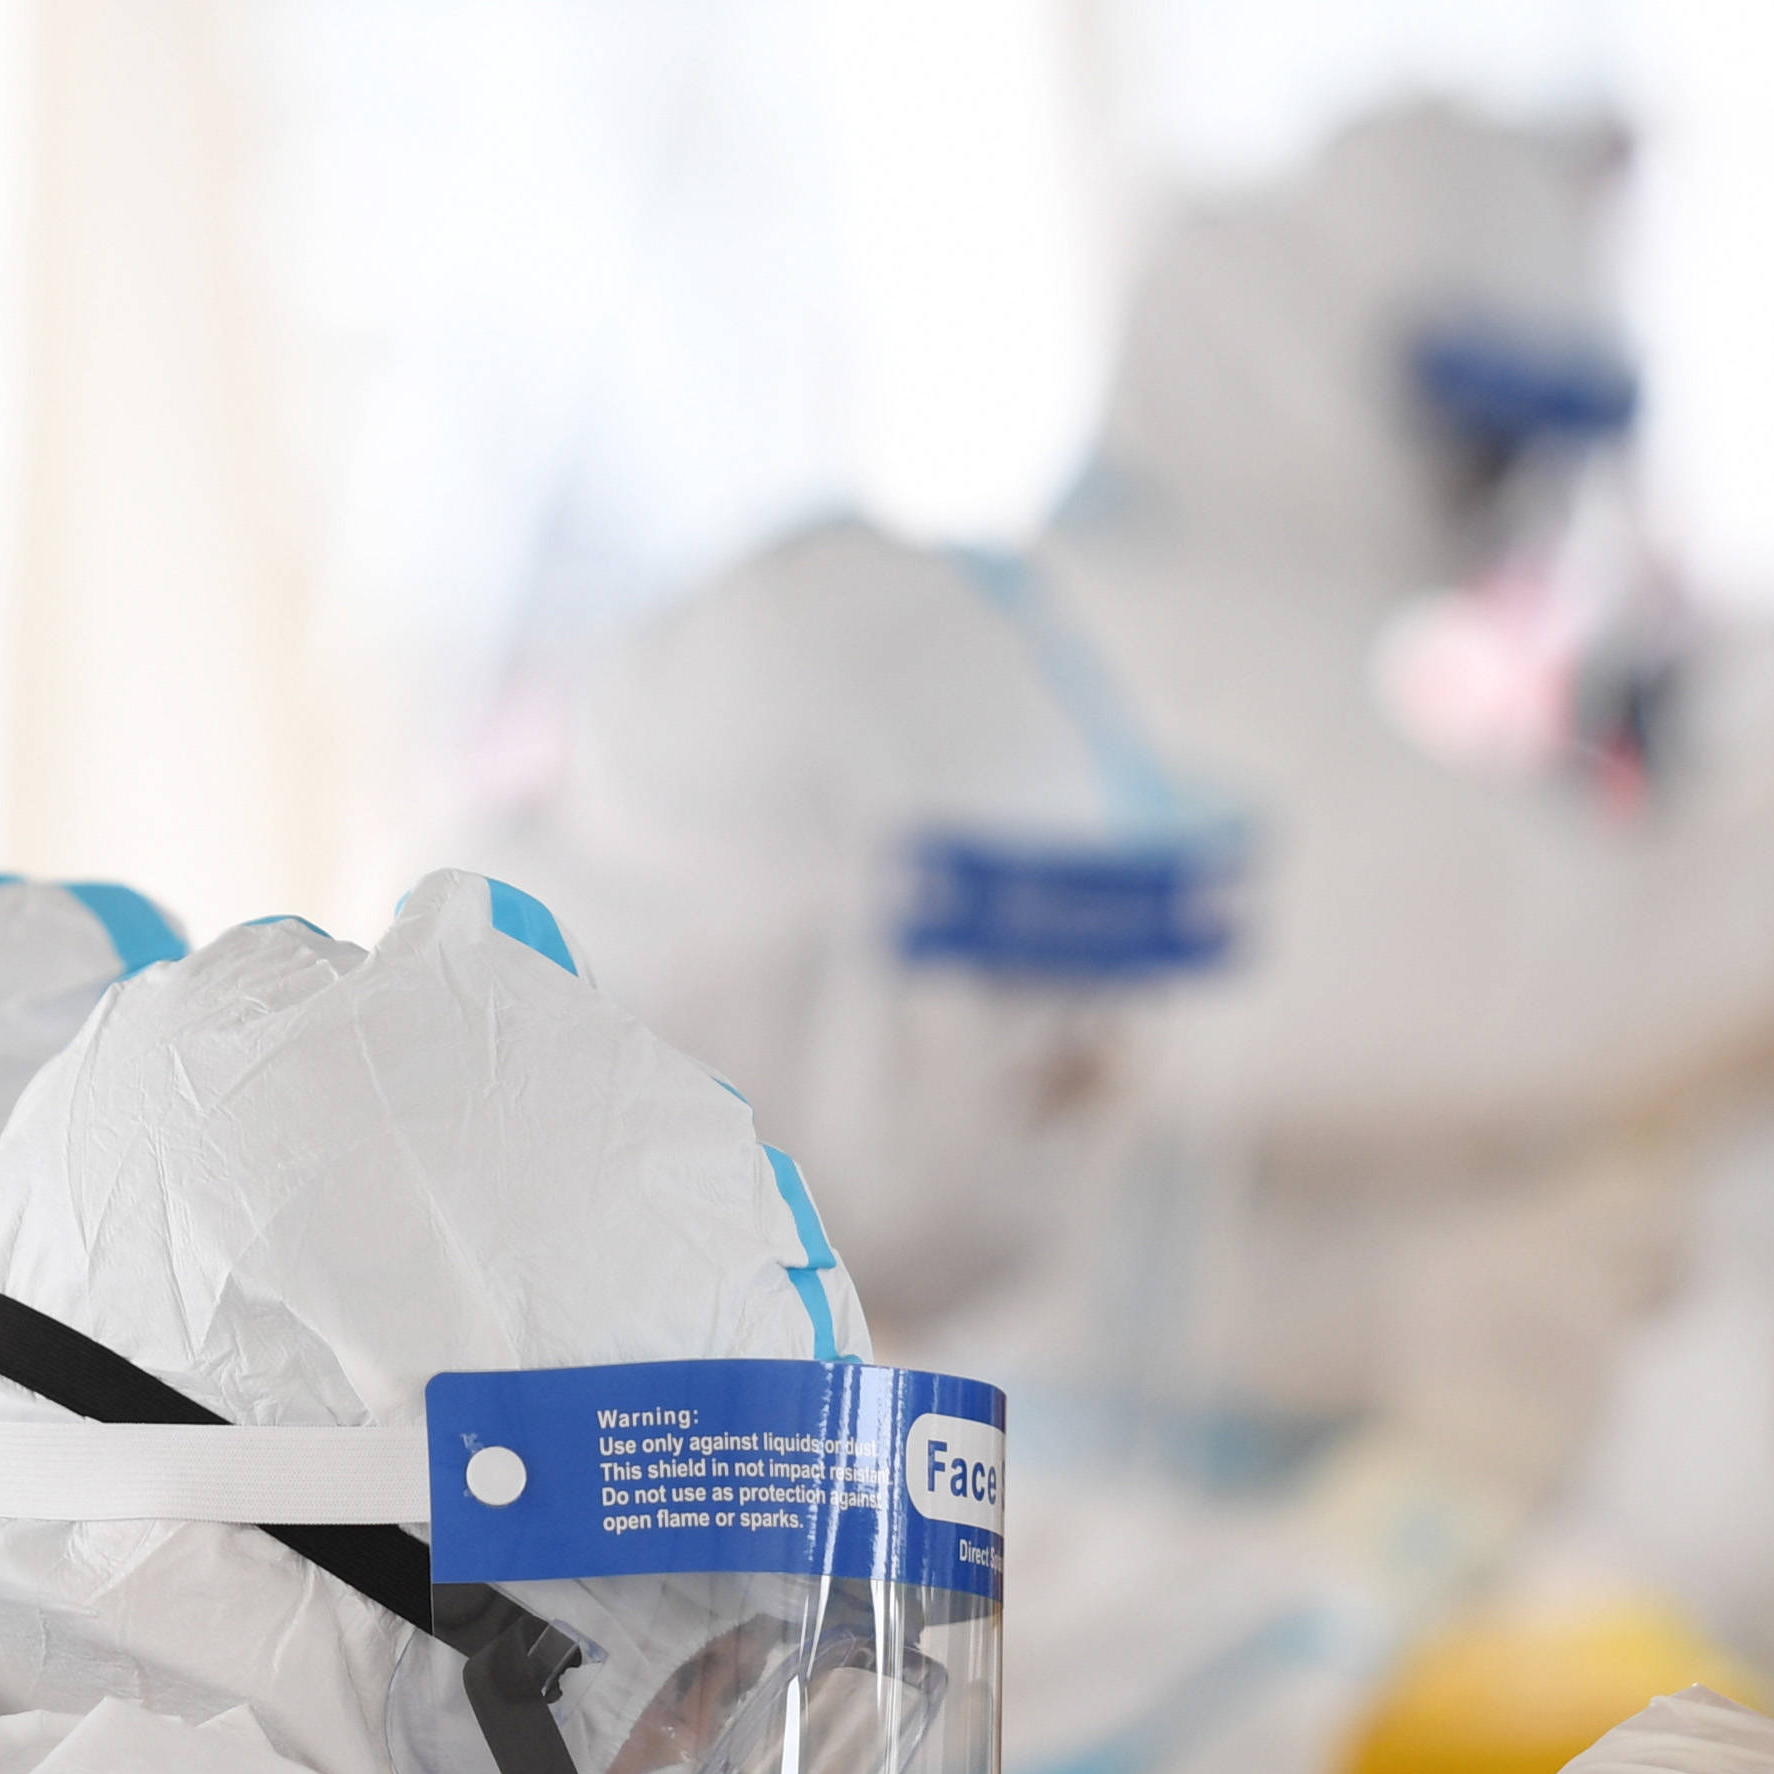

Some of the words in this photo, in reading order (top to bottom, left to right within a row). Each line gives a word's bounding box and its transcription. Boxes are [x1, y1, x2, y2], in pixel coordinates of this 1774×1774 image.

[597, 1406, 699, 1429] Warning:
[599, 1436, 637, 1456] Use
[642, 1432, 684, 1456] only
[689, 1431, 758, 1456] against
[763, 1431, 820, 1456] liquids
[824, 1438, 841, 1454] or
[600, 1461, 643, 1482] This
[647, 1458, 706, 1480] shield
[712, 1457, 729, 1477] in
[734, 1459, 765, 1478] not
[769, 1458, 826, 1483] impact
[927, 1439, 997, 1505] Face
[602, 1486, 629, 1507] Do
[634, 1484, 667, 1504] not
[671, 1486, 707, 1502] use
[712, 1486, 734, 1502] as
[739, 1484, 826, 1506] protection
[603, 1513, 652, 1536] open
[656, 1508, 710, 1528] flame
[715, 1511, 736, 1527] or
[740, 1508, 804, 1532] sparks.
[959, 1538, 989, 1567] Direct
